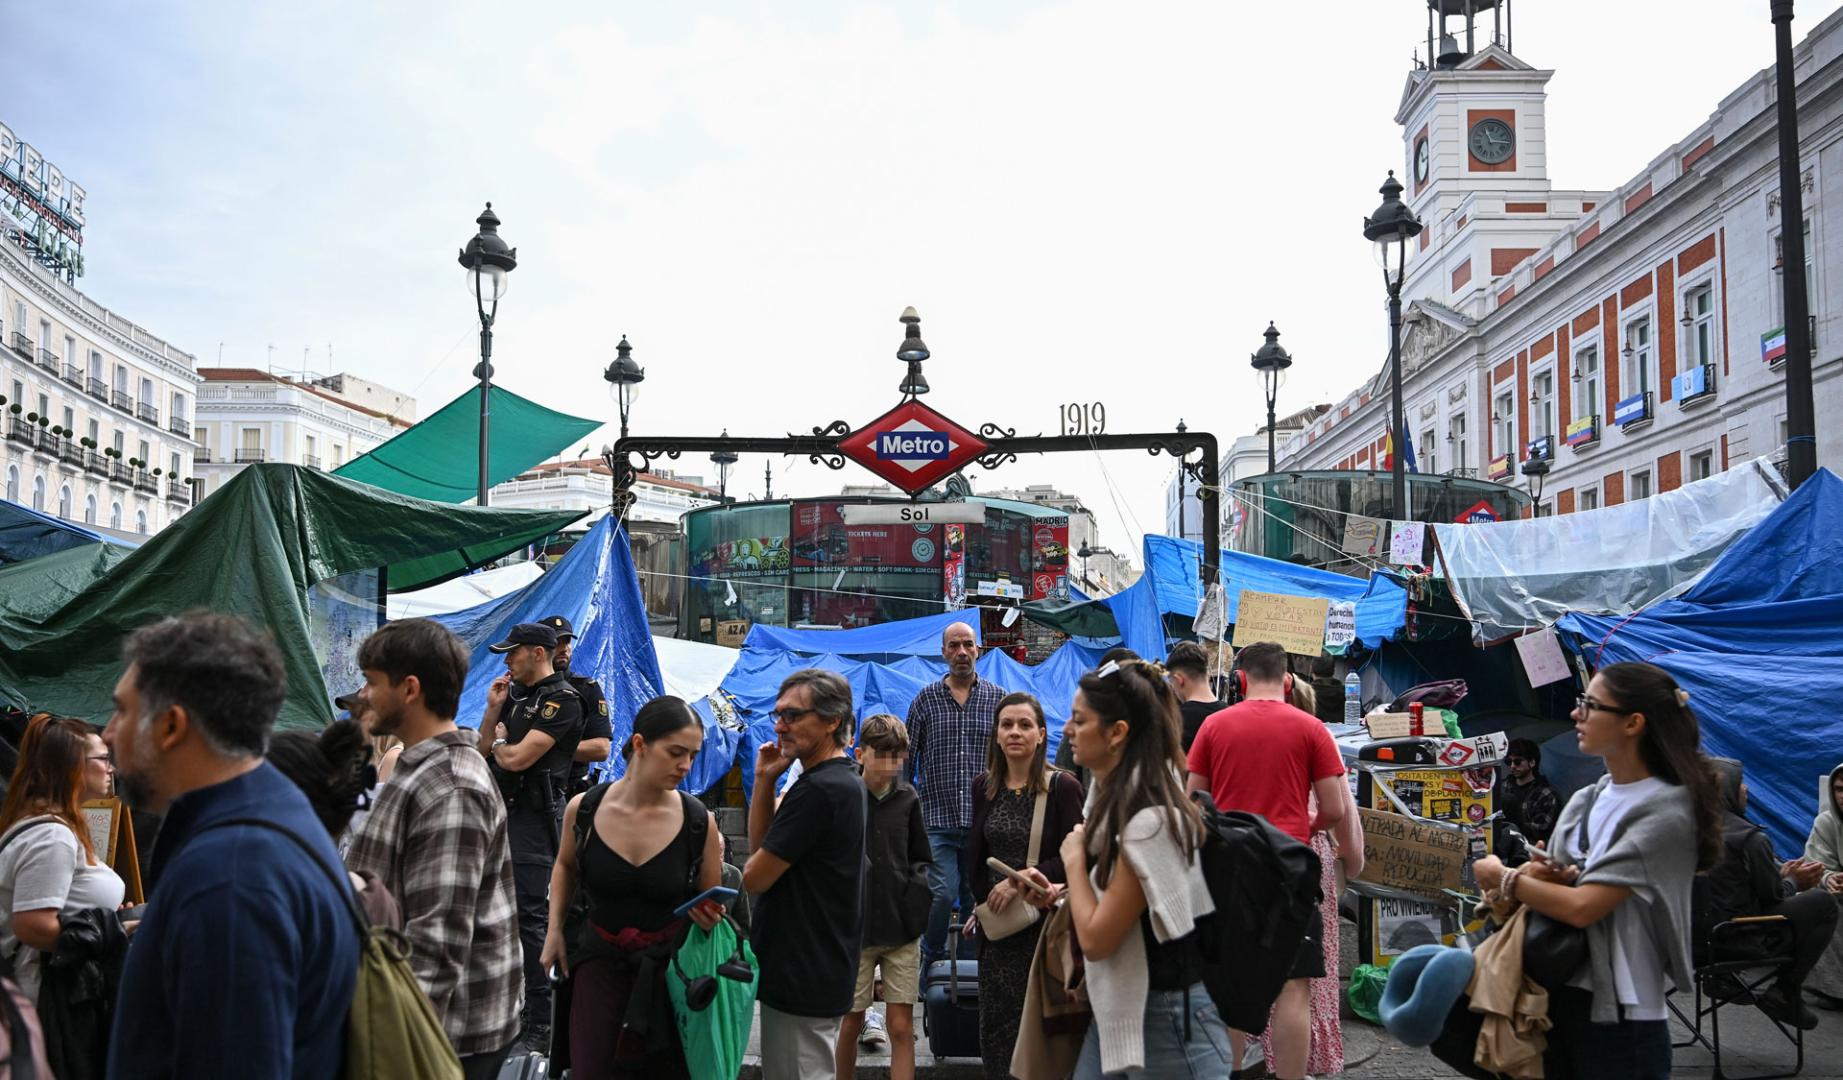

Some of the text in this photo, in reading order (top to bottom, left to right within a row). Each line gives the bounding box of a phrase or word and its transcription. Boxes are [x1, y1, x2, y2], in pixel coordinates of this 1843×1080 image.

[0, 121, 87, 226] PEPE
[1060, 401, 1105, 436] 1919
[883, 435, 945, 454] Metro
[901, 508, 929, 521] Sol
[1035, 516, 1069, 525] MADRID
[1328, 621, 1354, 631] humanos
[1423, 772, 1457, 780] DENTRO
[1410, 827, 1425, 843] AL
[1429, 831, 1464, 850] METRO
[1385, 846, 1449, 871] MOVILIDAD
[1383, 861, 1443, 885] REDUCIDA
[1381, 899, 1434, 917] PRO VIVIEND
